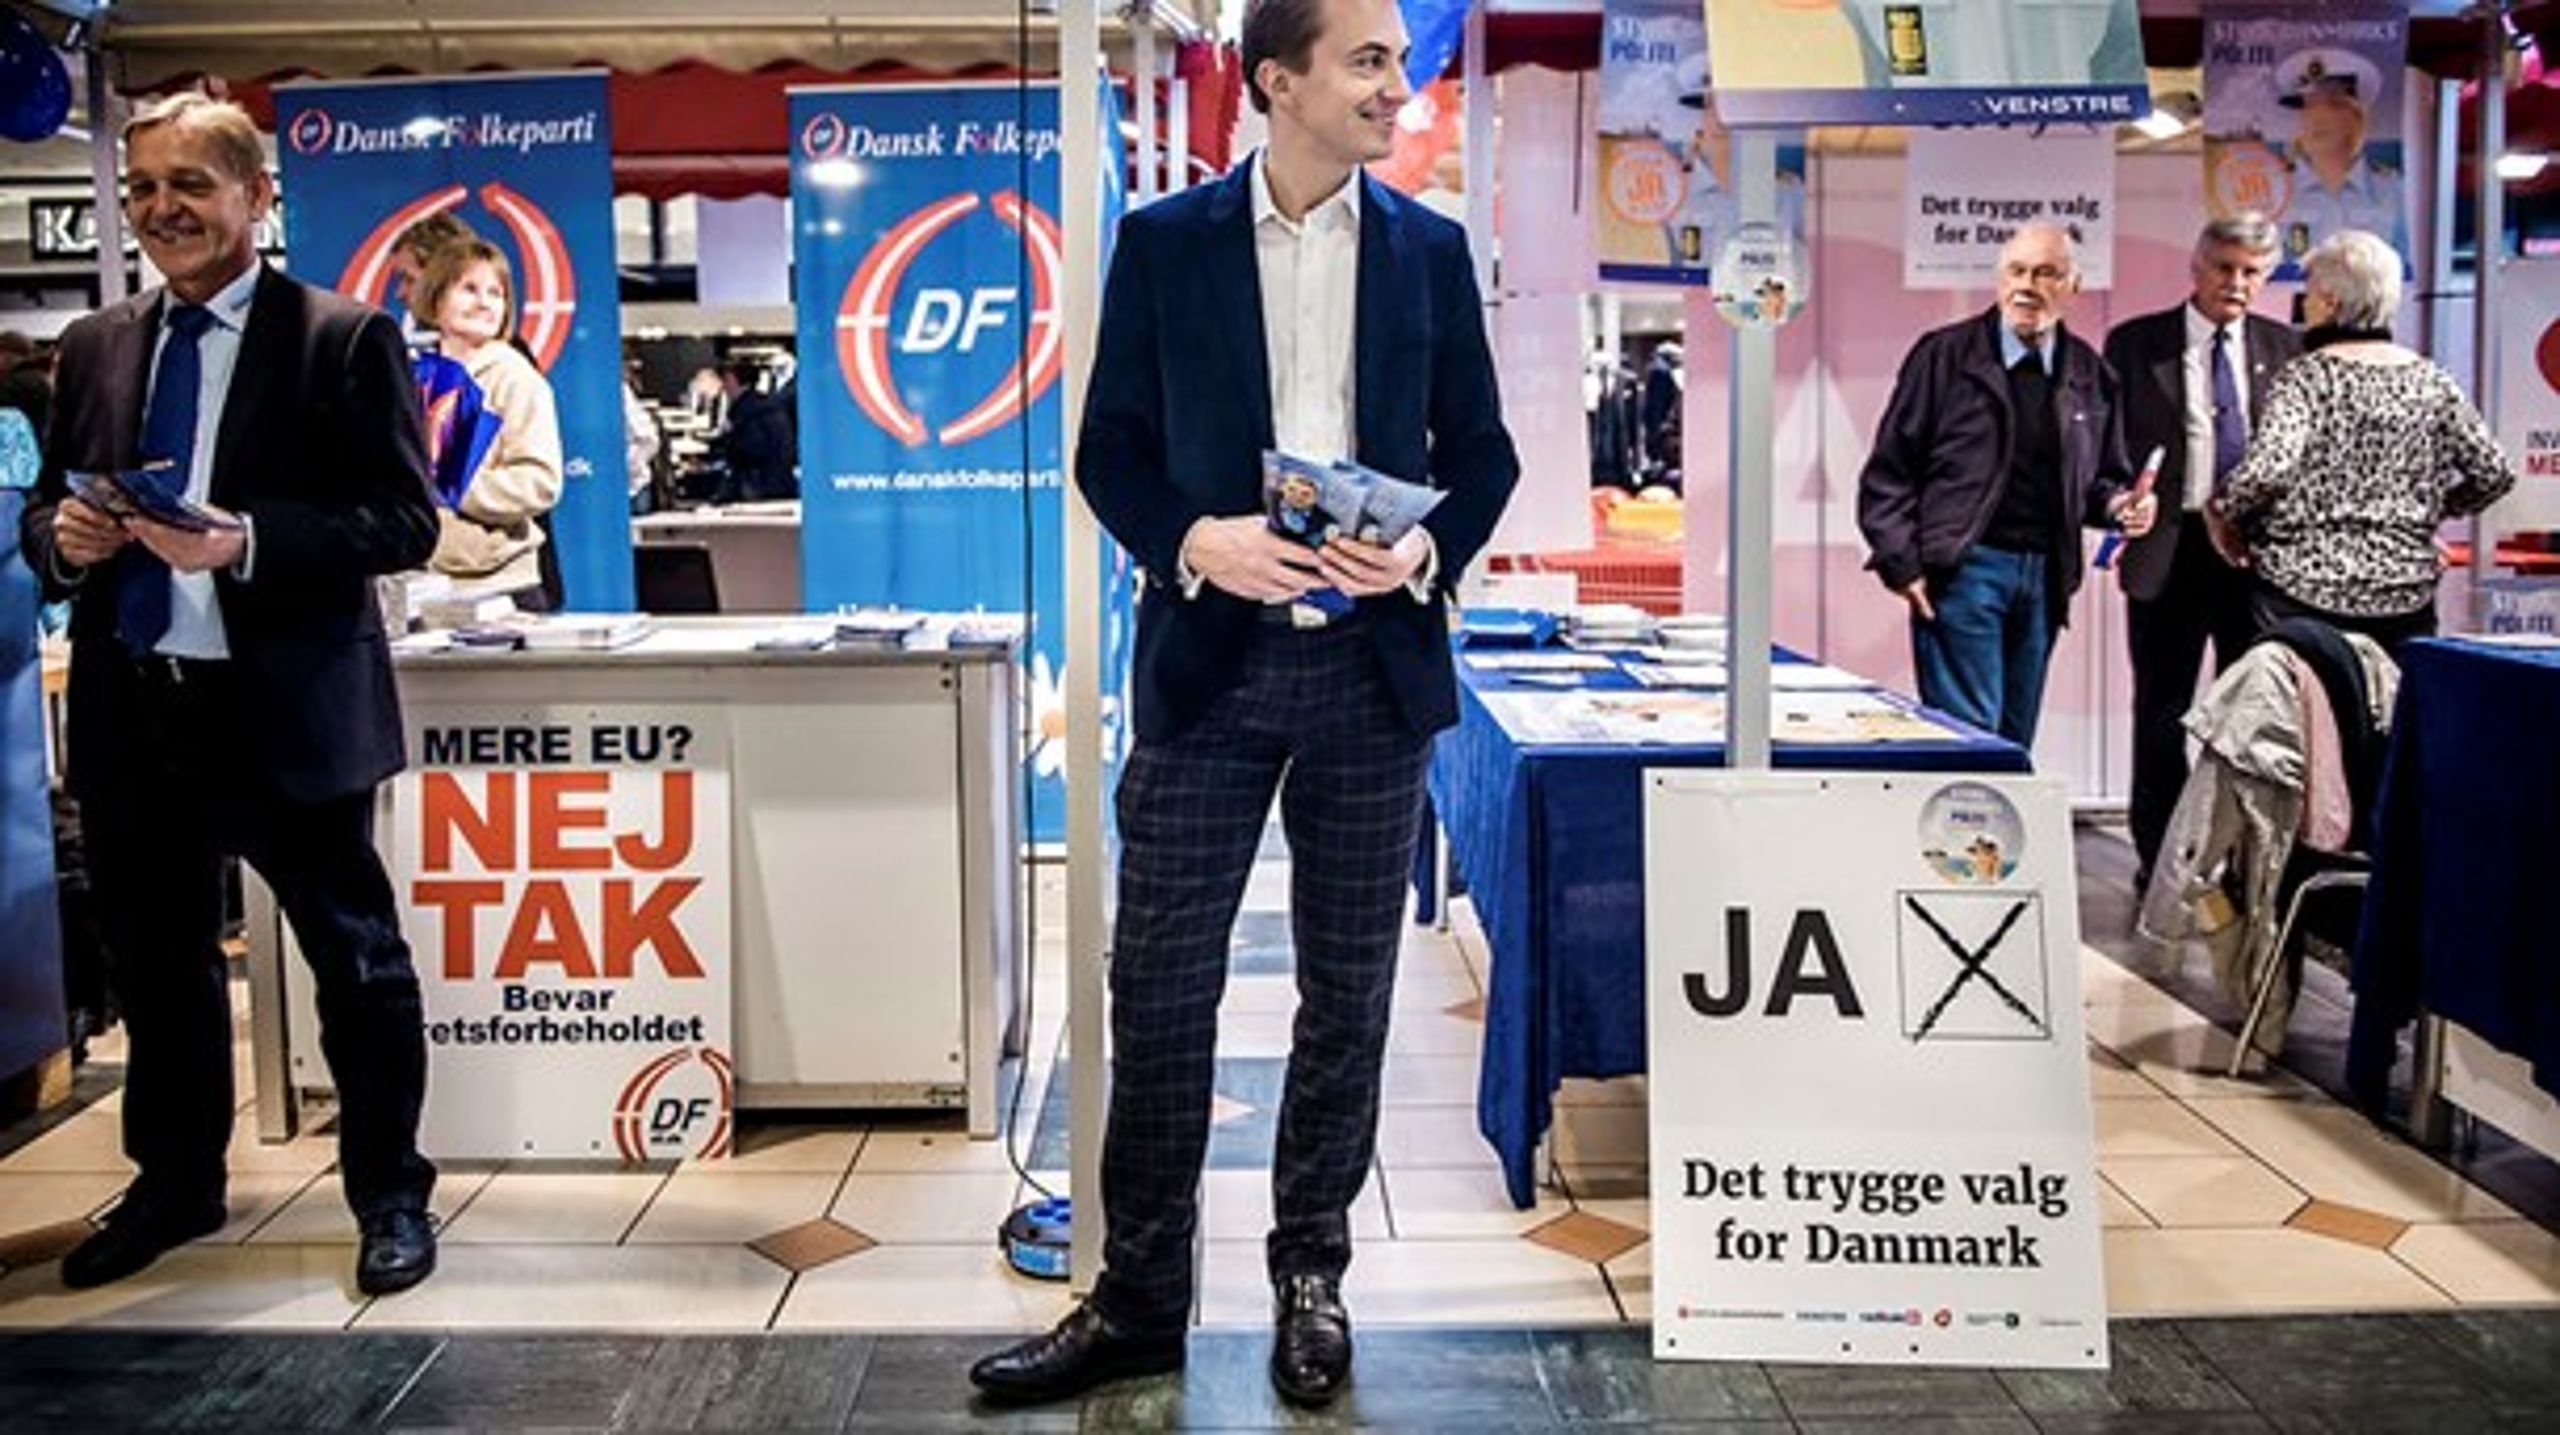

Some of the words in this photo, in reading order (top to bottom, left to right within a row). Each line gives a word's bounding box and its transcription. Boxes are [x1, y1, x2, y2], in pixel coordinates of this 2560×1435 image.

[1984, 95, 2133, 114] VENSTRE
[335, 116, 428, 153] Dans
[442, 112, 597, 154] Folkeparti
[848, 122, 945, 157] Dansk
[1921, 196, 1961, 215] Det
[1967, 197, 2043, 221] trygge
[2051, 194, 2100, 221] valg
[1934, 221, 1969, 244] for
[901, 287, 1017, 353] DF
[422, 726, 572, 764] MERE
[591, 725, 693, 763] EU?
[422, 772, 693, 872] NEJ
[411, 879, 705, 979] TAK
[1682, 907, 1865, 1019] JA
[503, 984, 615, 1012] Bevar
[423, 1014, 704, 1045] etsforbeholdet
[650, 1098, 712, 1130] DF
[1683, 1160, 1767, 1200] Det
[1784, 1164, 1945, 1217] trygge
[1961, 1164, 2069, 1218] valg
[1716, 1219, 1788, 1262] for
[1805, 1224, 2041, 1268] Danmark
